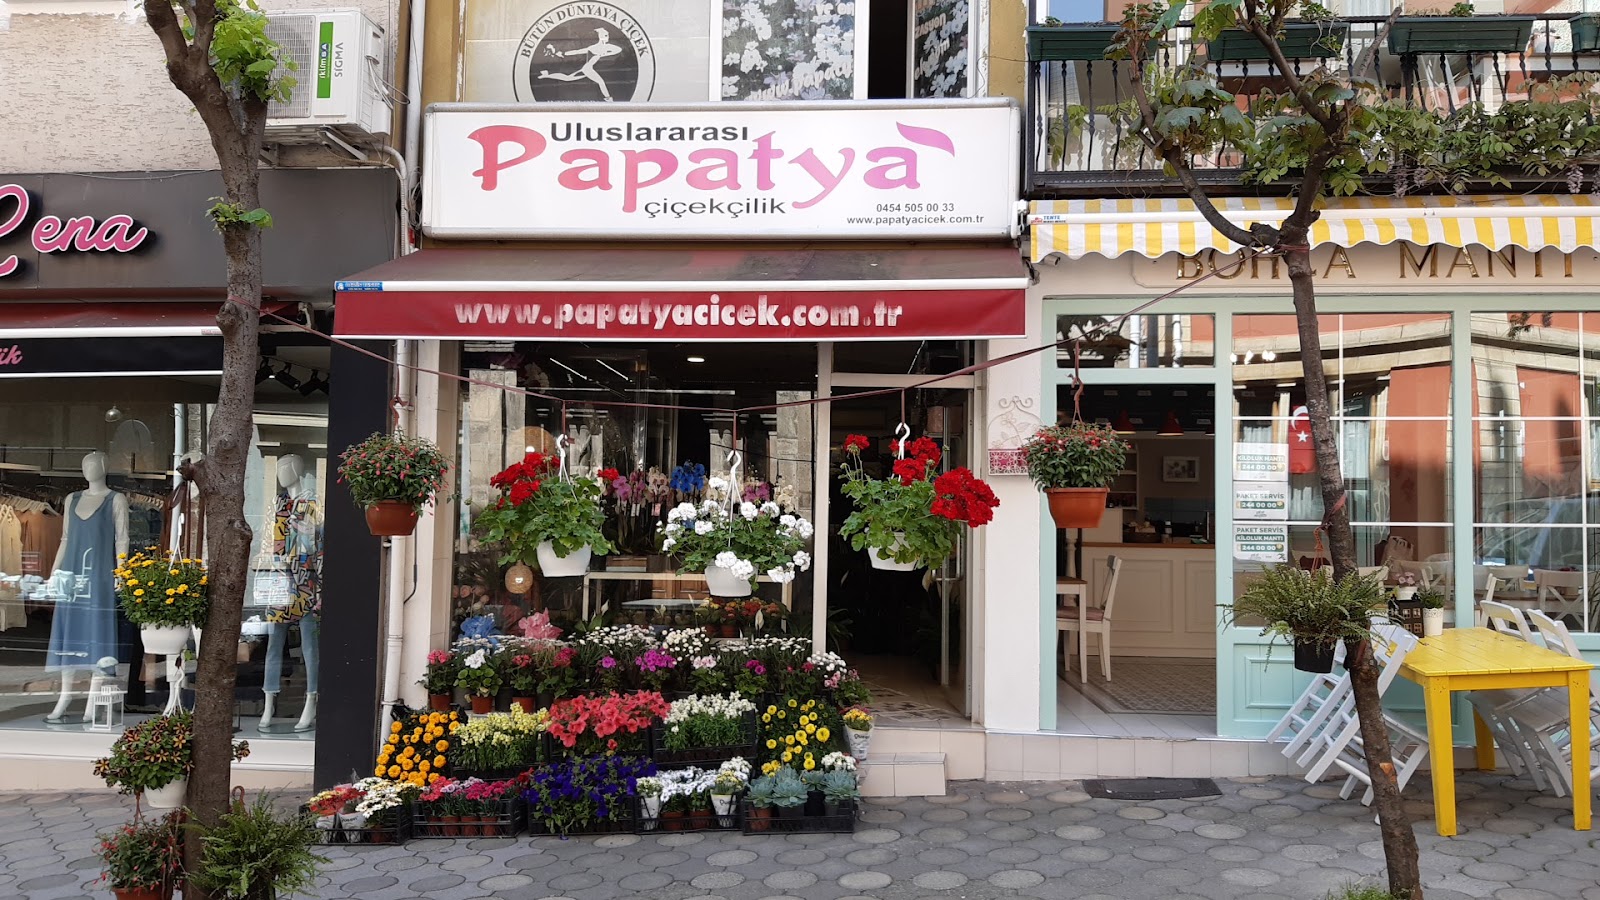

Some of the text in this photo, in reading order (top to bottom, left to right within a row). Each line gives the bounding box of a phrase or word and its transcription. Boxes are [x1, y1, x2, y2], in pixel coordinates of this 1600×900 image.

[520, 4, 649, 59] BÜTÜN DÜNYAYA ÇİÇEK
[550, 122, 748, 142] Uluslararası
[467, 124, 922, 213] Papatya
[643, 198, 786, 219] çiçekçilik
[846, 214, 984, 226] www.papatyacicek.com.tr
[876, 202, 955, 213] 0454 505 00 33
[1176, 245, 1356, 280] BOHA
[453, 294, 903, 330] www.papatyacicek.com.tr
